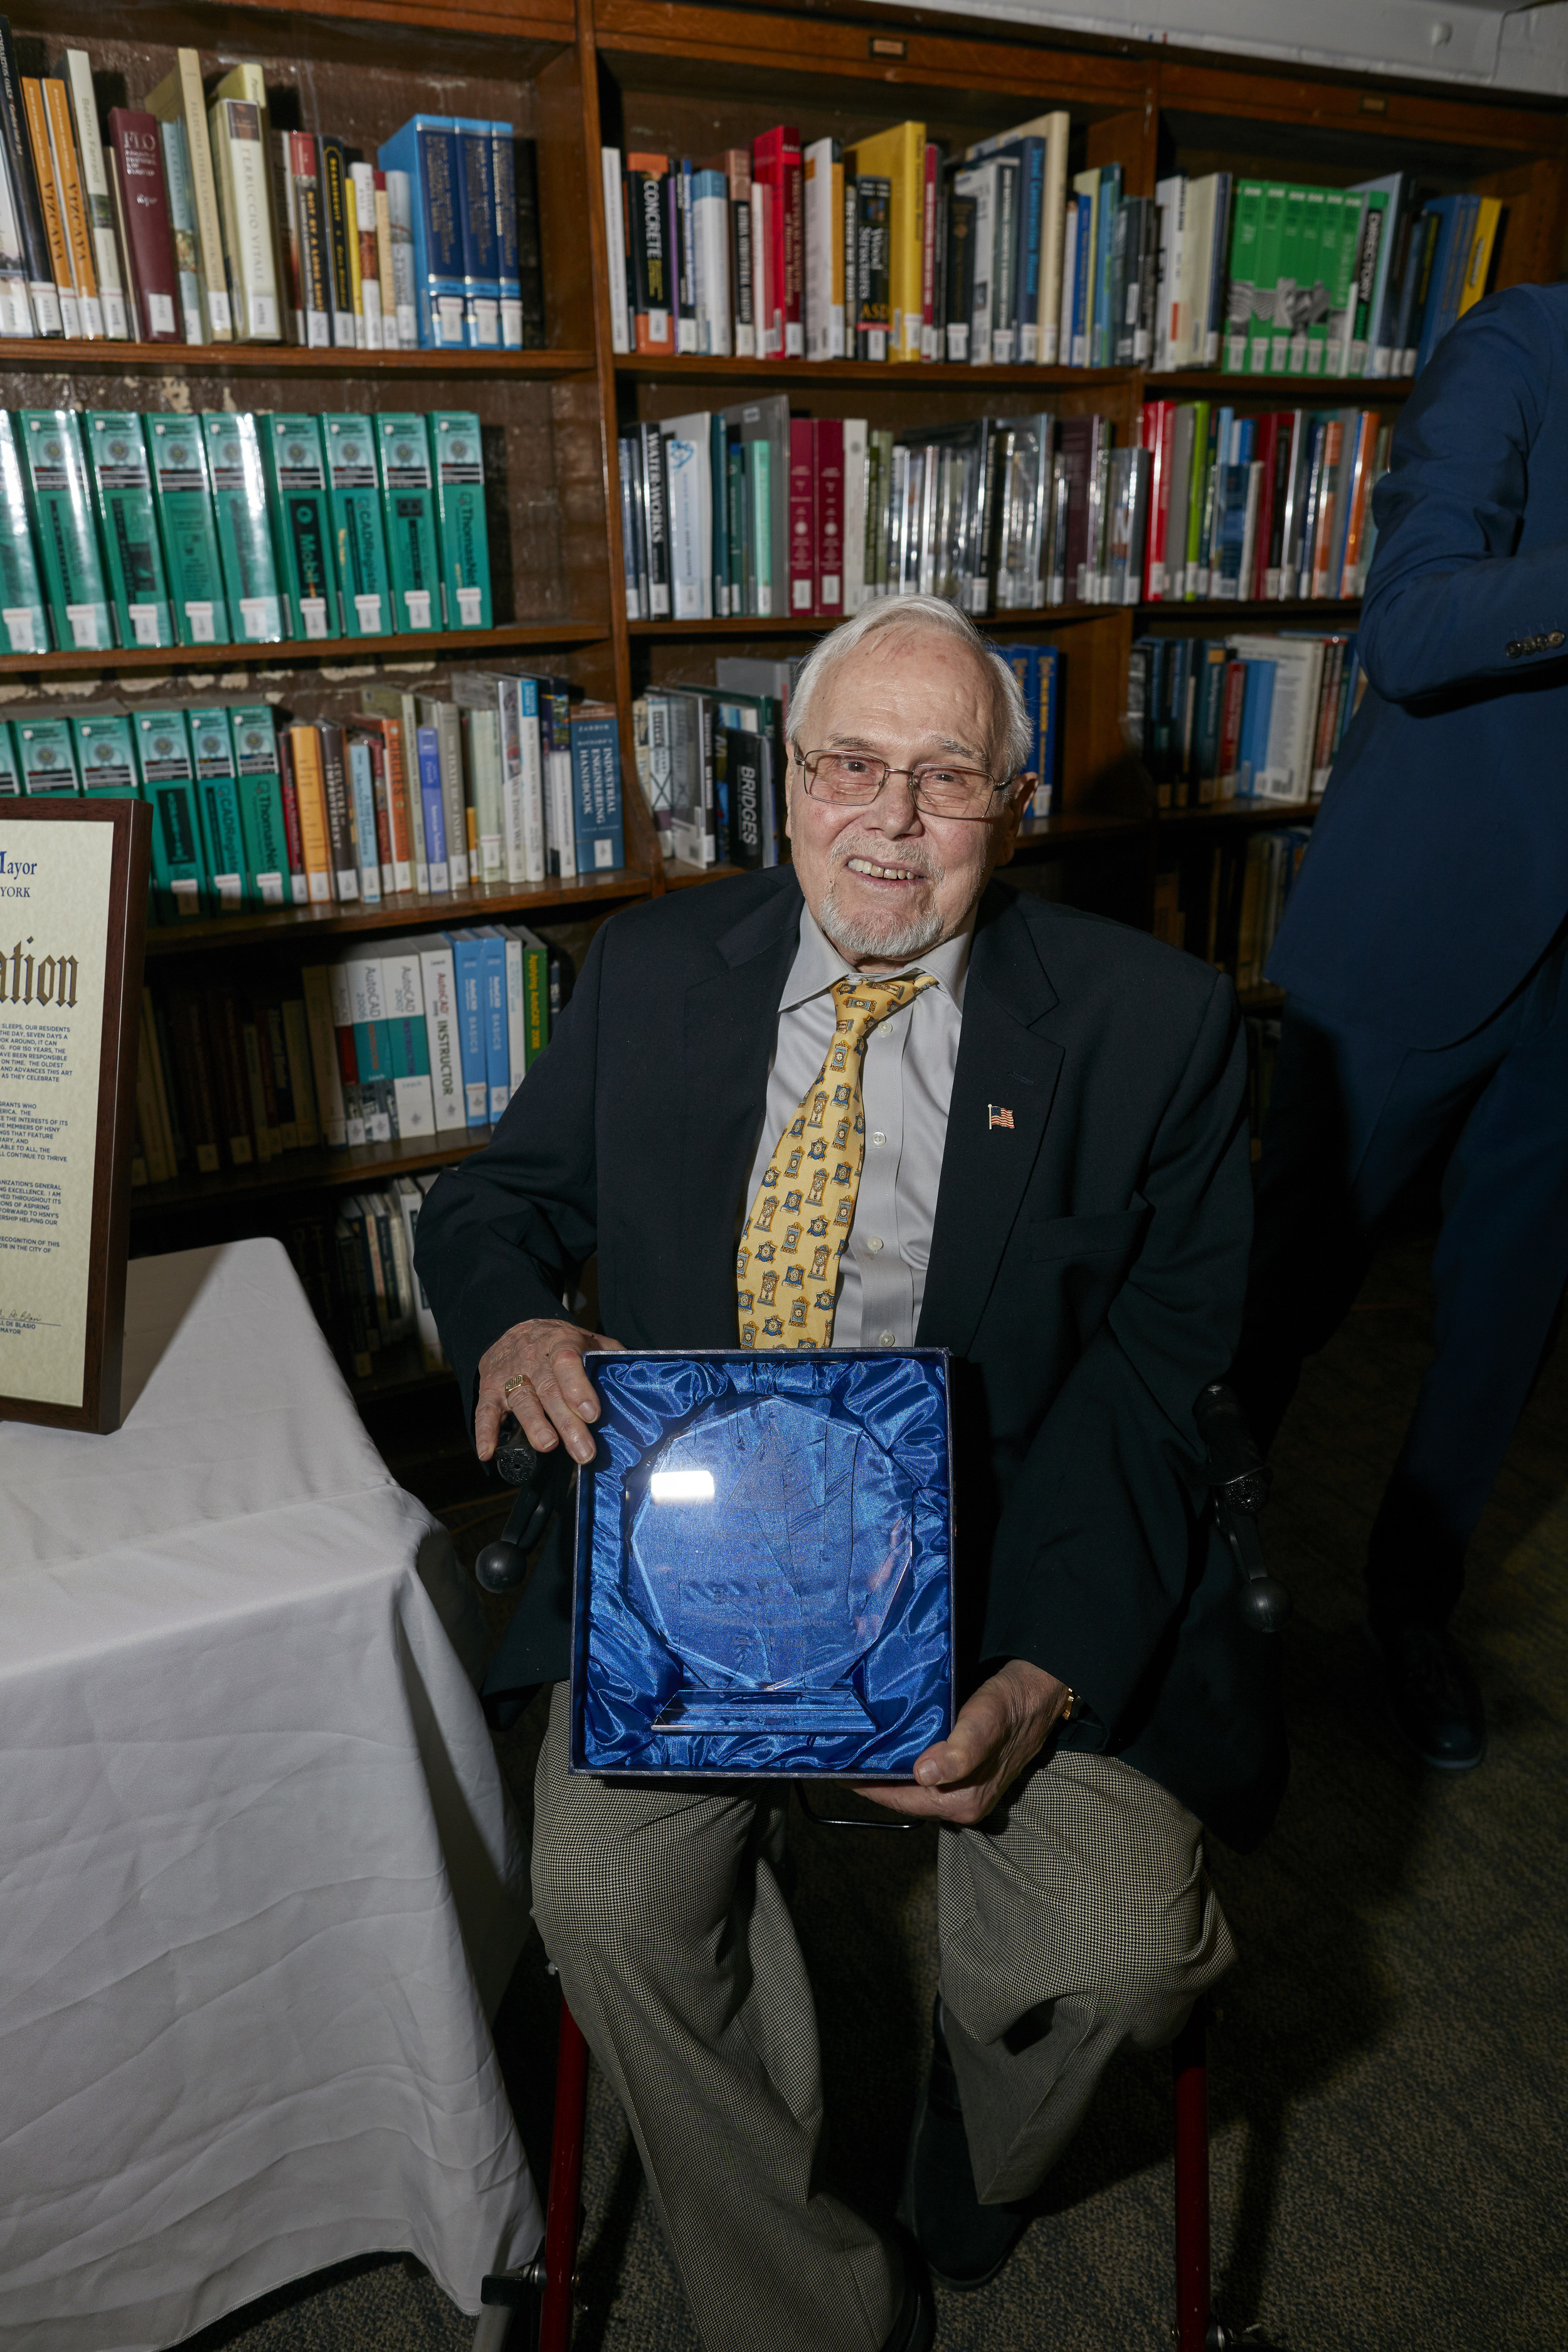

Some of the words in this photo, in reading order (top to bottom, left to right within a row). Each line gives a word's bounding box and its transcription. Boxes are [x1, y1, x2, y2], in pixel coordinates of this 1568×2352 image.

[82, 98, 93, 139] Beatrix
[89, 141, 102, 184] Farrand
[1030, 148, 1044, 178] Steel
[241, 147, 260, 230] FERRUCCIO
[251, 235, 263, 280] VITALE
[307, 191, 316, 215] NOT
[329, 157, 341, 222] SEABISCUIT
[44, 181, 63, 261] VIZCAYA
[68, 182, 87, 262] VIZCAYA
[309, 218, 317, 234] BY
[643, 180, 662, 259] CONCRETE
[1028, 181, 1042, 250] Construction
[310, 236, 319, 246] A
[311, 248, 320, 279] LONG
[859, 226, 872, 300] Structures
[871, 228, 884, 270] Wood
[1358, 212, 1381, 302] DIRECTORY
[314, 281, 324, 311] SHOT
[1026, 253, 1039, 295] Manual
[647, 432, 664, 543] WATER-WORKS
[299, 533, 320, 583] Mobil
[459, 507, 479, 586] ThomasNet
[335, 762, 346, 815] CULTURE
[388, 738, 405, 796] CIRCLES
[580, 749, 593, 815] HANDBOOK
[591, 748, 606, 824] ENGINEERING
[603, 747, 617, 815] INDUSTRIAL
[325, 763, 342, 850] IMPROVEMENT
[739, 765, 758, 845] BRIDGES
[256, 793, 278, 872] ThomasNet
[0, 887, 30, 898] YORK
[366, 967, 382, 1019] AutoCAD
[401, 965, 415, 1013] AutoCAD
[437, 972, 449, 1015] AutoCAD
[468, 978, 478, 1012] AutoCAD
[491, 975, 501, 1009] AutoCAD
[528, 954, 539, 989] Applying
[356, 992, 368, 1019] 2006
[394, 988, 405, 1014] 2007
[530, 991, 541, 1027] AutoCAD
[469, 1015, 479, 1054] BASICS
[492, 1014, 501, 1052] BASICS
[368, 1073, 385, 1081] Leach
[437, 1020, 455, 1096] INSTRUCTOR
[402, 1080, 422, 1089] Leach
[12, 1195, 51, 1203] THROUGHOUT
[1, 1327, 21, 1335] MAYOR
